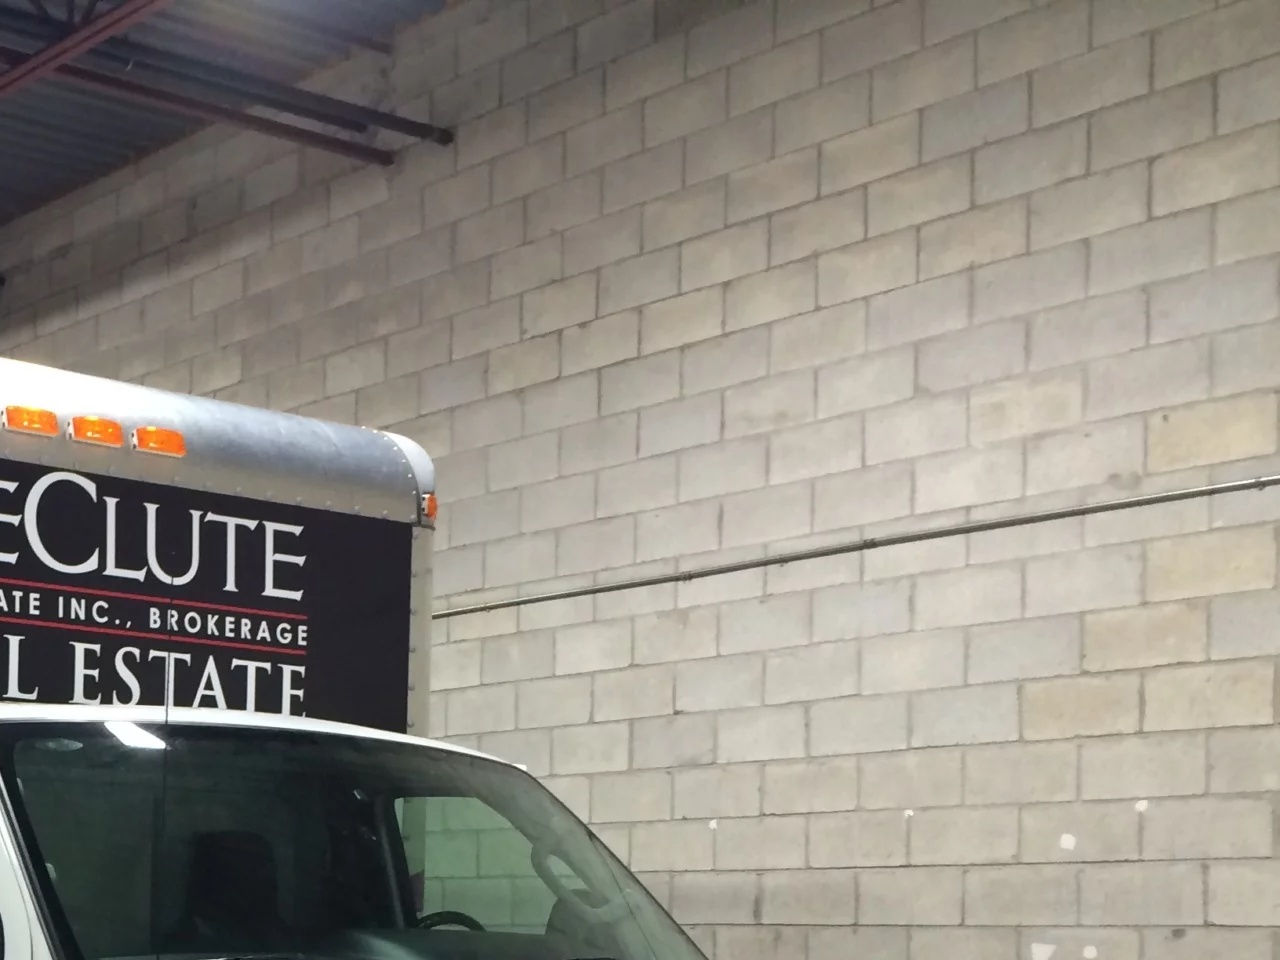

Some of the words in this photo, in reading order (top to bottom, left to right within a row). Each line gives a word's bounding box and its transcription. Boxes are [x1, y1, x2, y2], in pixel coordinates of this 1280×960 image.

[58, 597, 132, 628] INC.,
[149, 606, 309, 646] BROKERAGE
[68, 641, 307, 718] ESTATE
